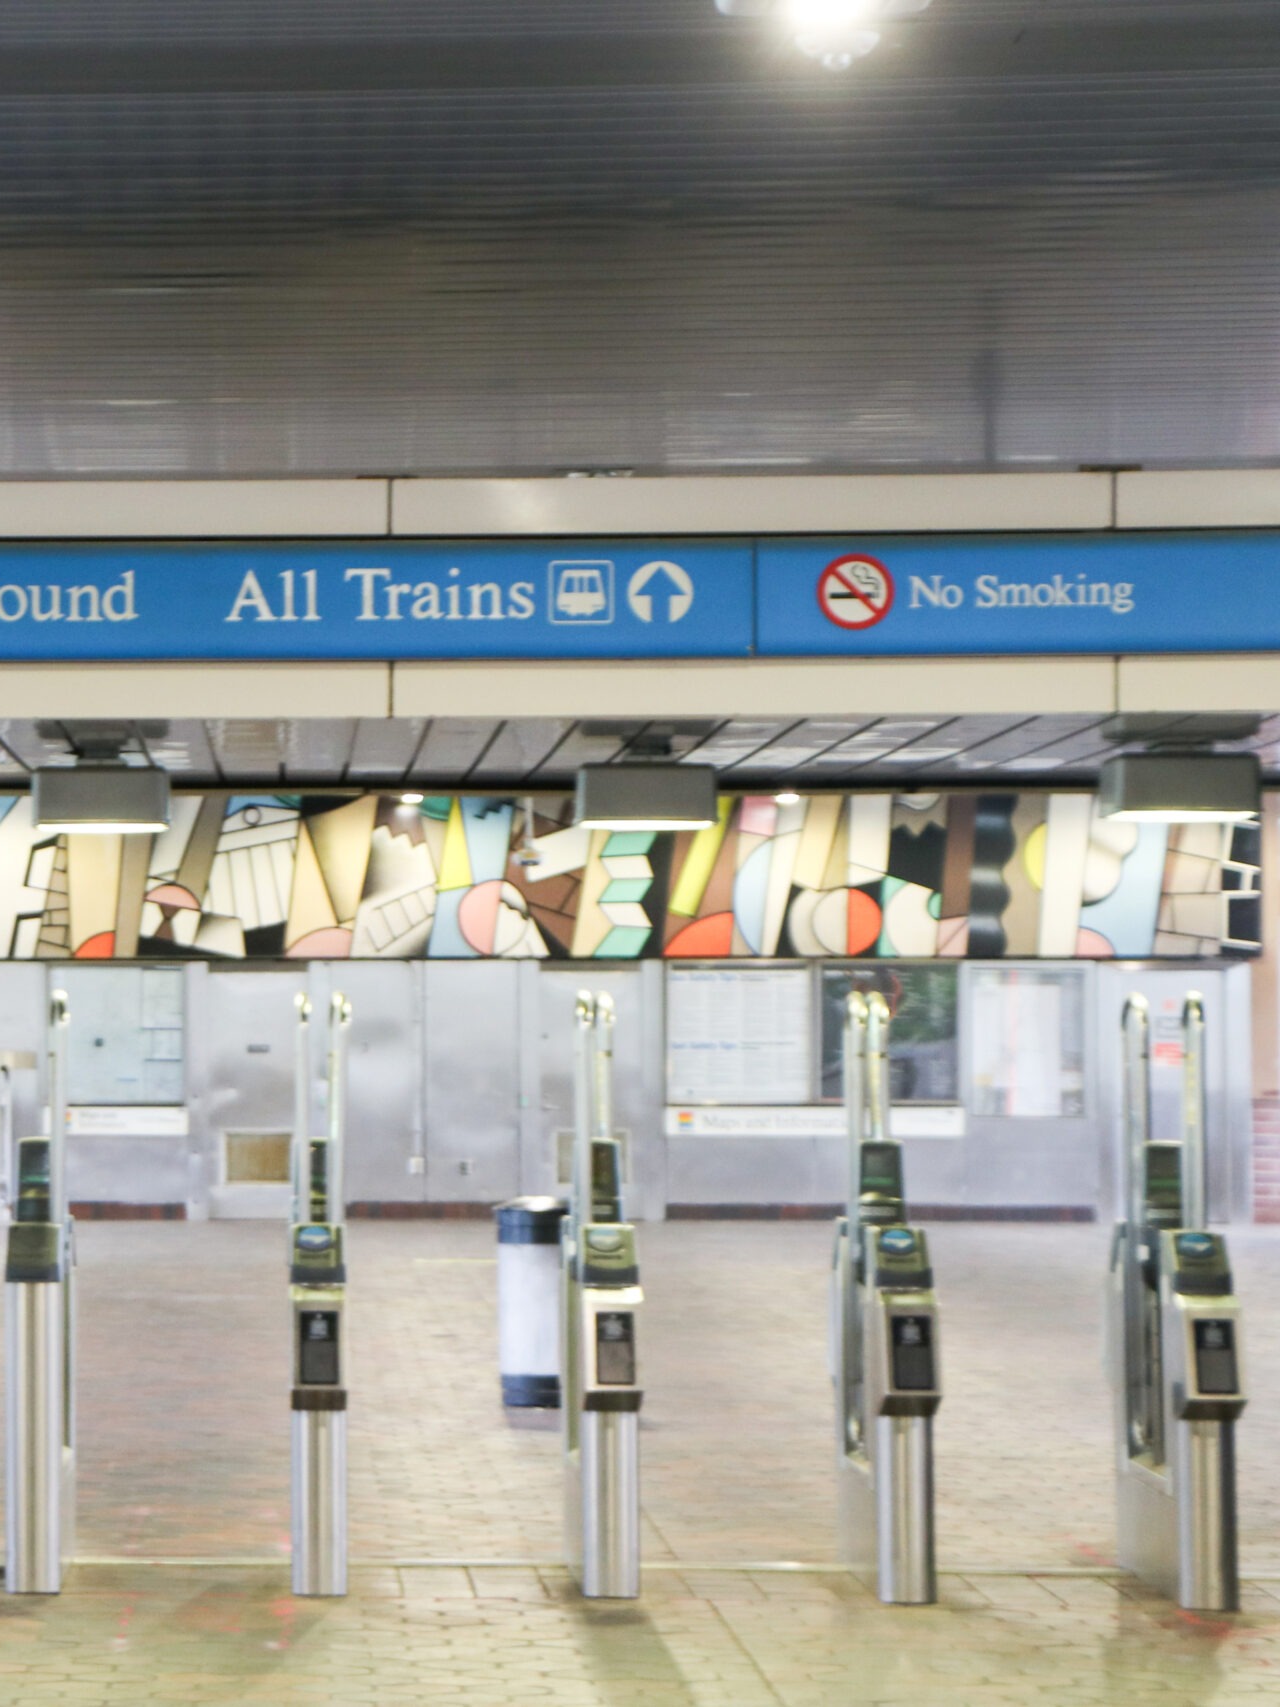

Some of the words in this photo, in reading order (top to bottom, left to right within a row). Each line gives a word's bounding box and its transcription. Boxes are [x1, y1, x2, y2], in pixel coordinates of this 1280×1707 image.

[224, 568, 322, 622] All
[343, 566, 536, 621] Trains
[908, 575, 964, 609] No
[973, 572, 1135, 614] Smoking
